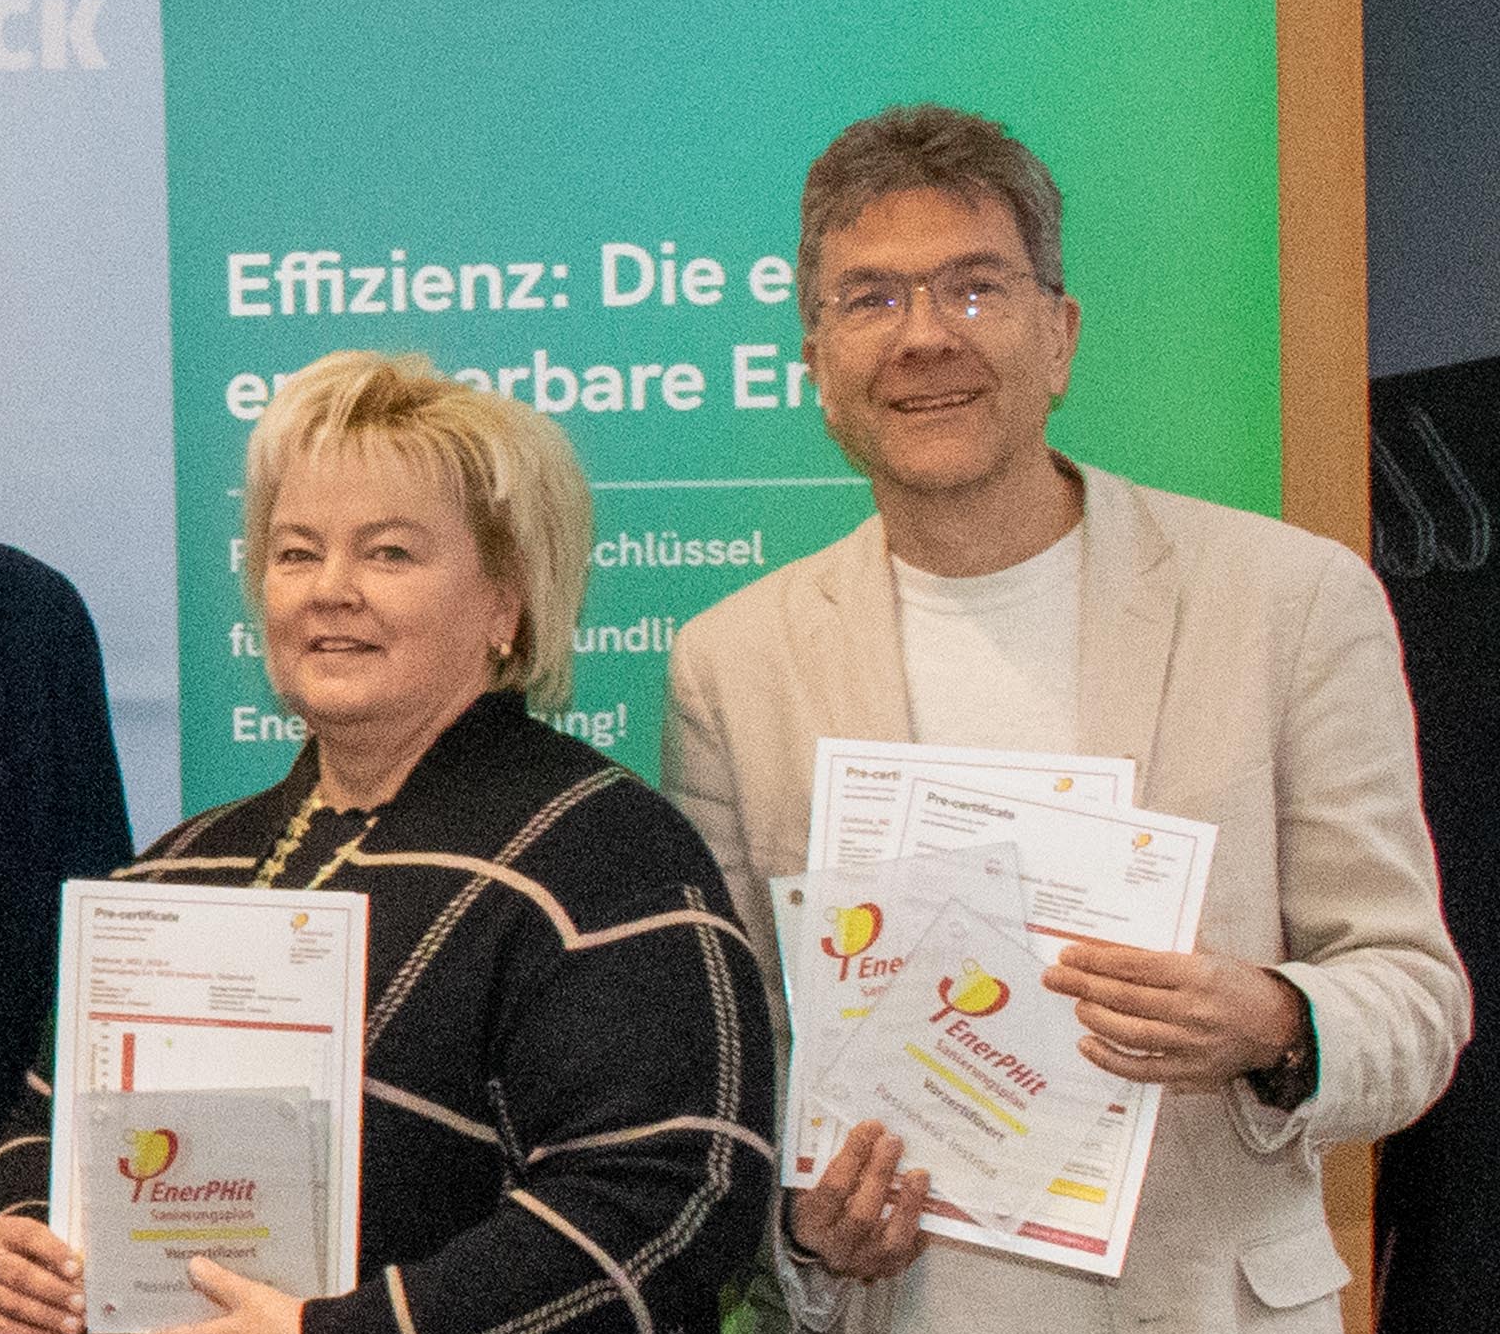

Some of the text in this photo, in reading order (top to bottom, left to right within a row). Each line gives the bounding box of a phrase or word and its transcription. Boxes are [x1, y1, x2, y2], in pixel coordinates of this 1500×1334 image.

[227, 241, 796, 317] Effizienz: Die e
[597, 530, 764, 567] chlüssel
[232, 706, 306, 743] Ene
[926, 790, 1016, 822] Pre-certificate
[93, 906, 180, 924] Pre-certificate
[857, 954, 904, 981] Ene
[945, 1018, 1048, 1097] EnerPHit
[150, 1178, 257, 1203] EnerPHit
